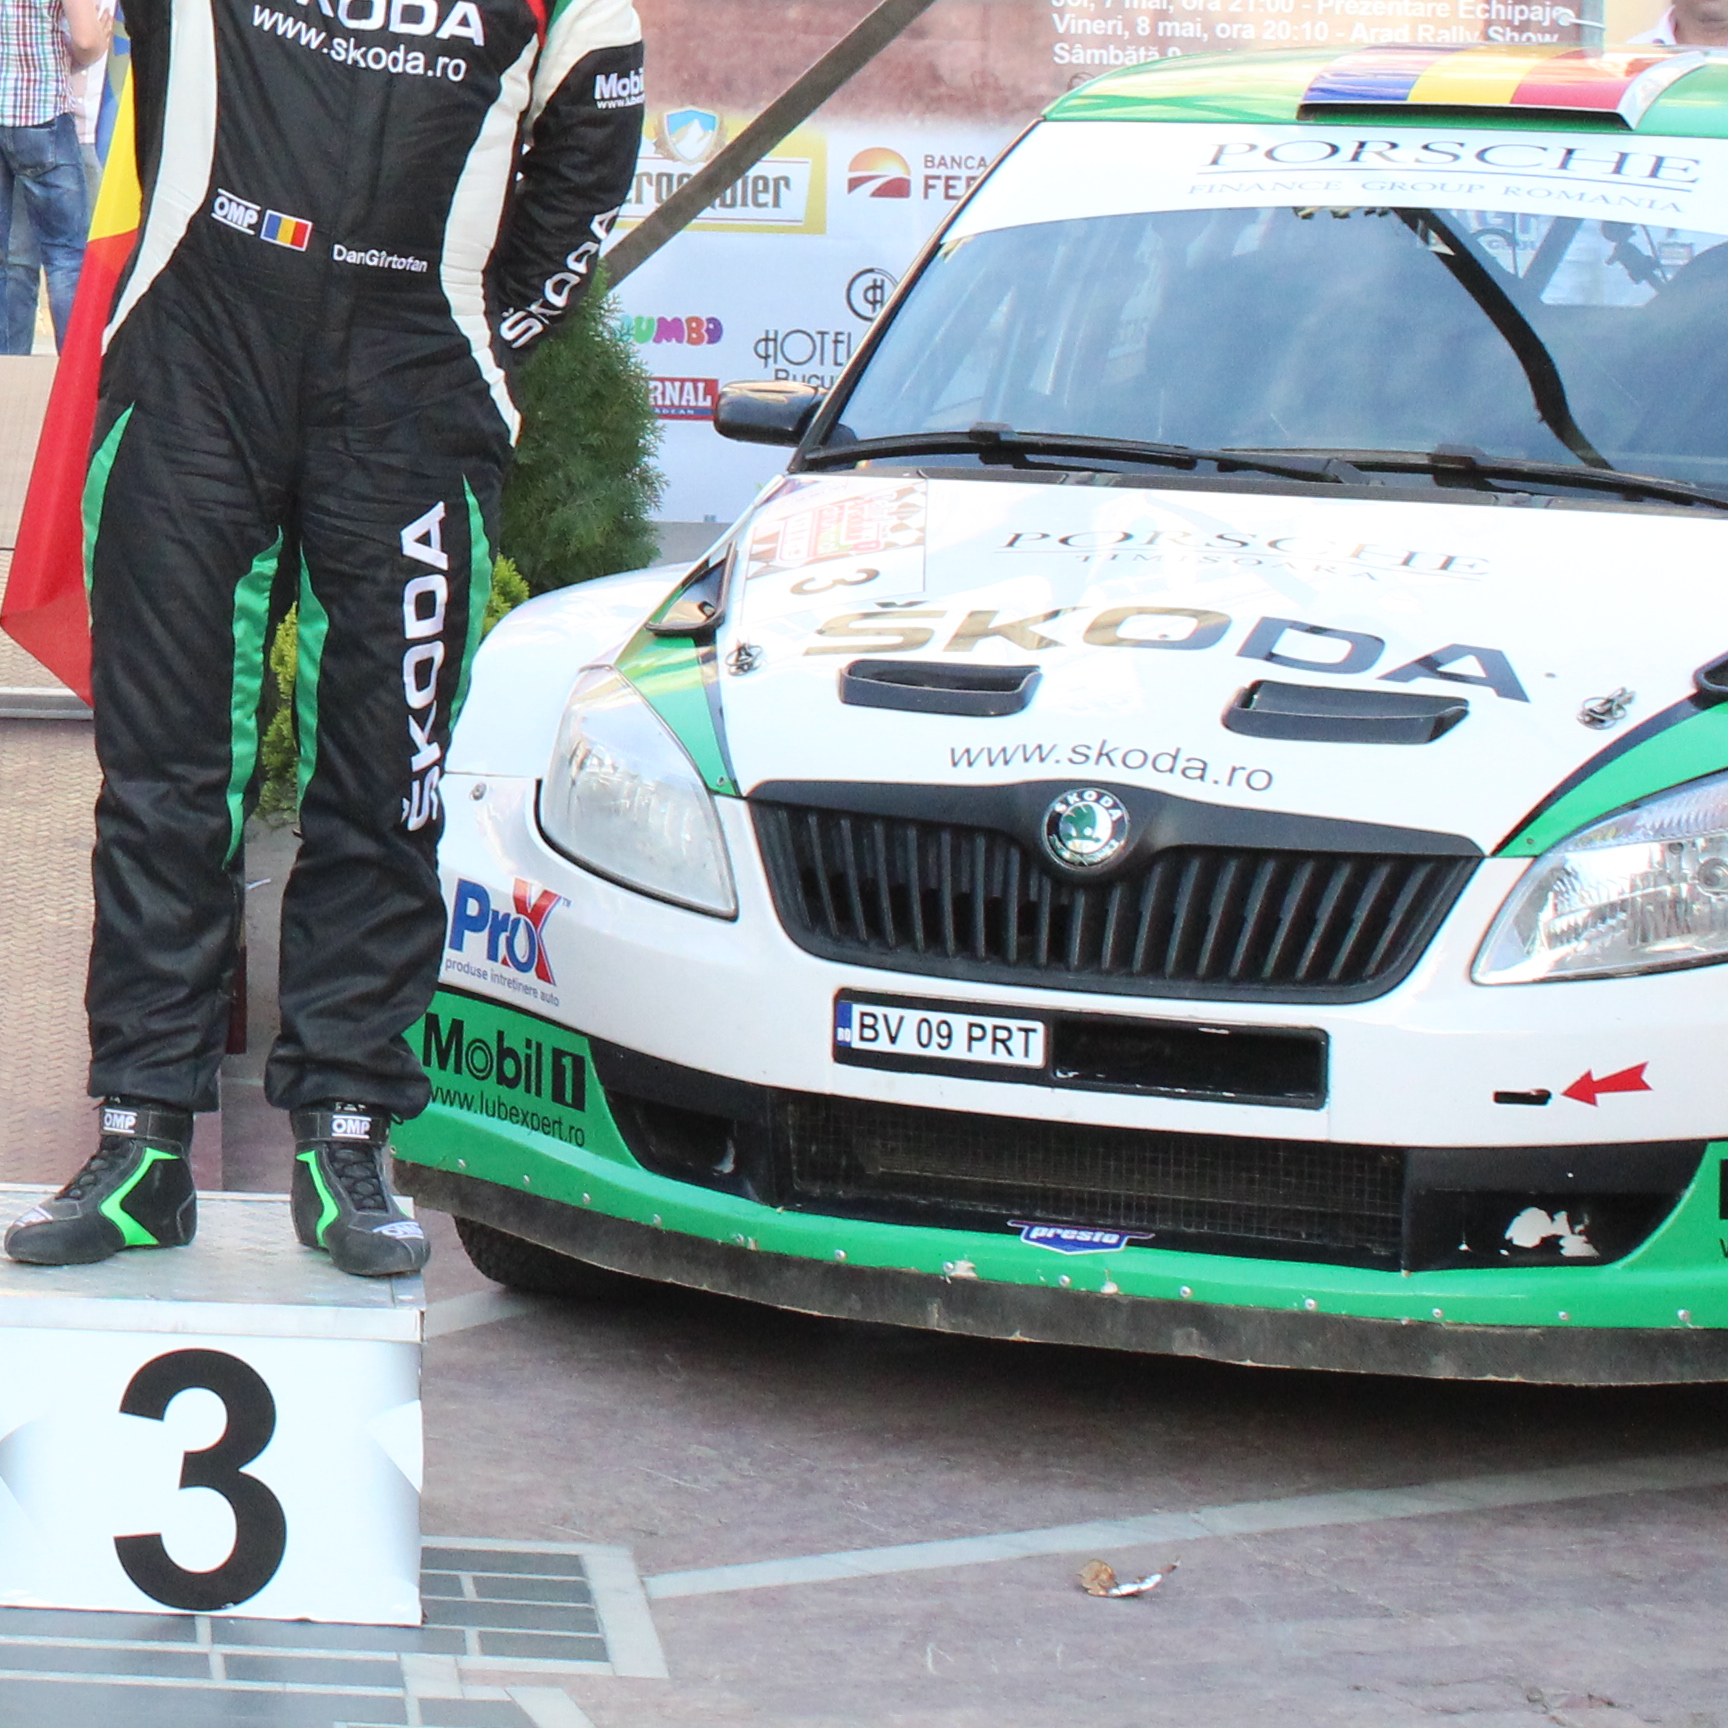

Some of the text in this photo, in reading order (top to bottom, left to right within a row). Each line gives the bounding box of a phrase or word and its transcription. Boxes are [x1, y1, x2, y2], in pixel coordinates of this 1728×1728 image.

[251, 4, 467, 83] www.skoda.ro
[1051, 13, 1131, 40] Vineri,
[1136, 16, 1151, 36] 8
[1156, 16, 1210, 41] mai,
[1215, 20, 1255, 40] ora
[1262, 18, 1329, 41] 20:10
[1349, 21, 1411, 44] Arad
[1204, 138, 1703, 186] PORSCHE
[213, 194, 260, 229] OMP
[1187, 178, 1687, 215] FINANCE GROUP ROMANIA
[753, 328, 853, 369] HOTEL
[998, 528, 1491, 576] PORSCHE
[1074, 553, 1381, 582] TIMISOARA
[398, 501, 451, 833] ŠKODA
[799, 597, 1532, 705] ŠKODA
[948, 738, 1275, 794] www.skoda.ro
[448, 876, 563, 987] ProX
[444, 957, 561, 1007] produse auto
[422, 1011, 543, 1099] Mobil
[858, 1012, 1038, 1059] BV 09 PRT
[103, 1113, 138, 1131] OMP
[331, 1118, 371, 1135] OMP
[1028, 1225, 1119, 1247] presto
[114, 1346, 289, 1613] 3
